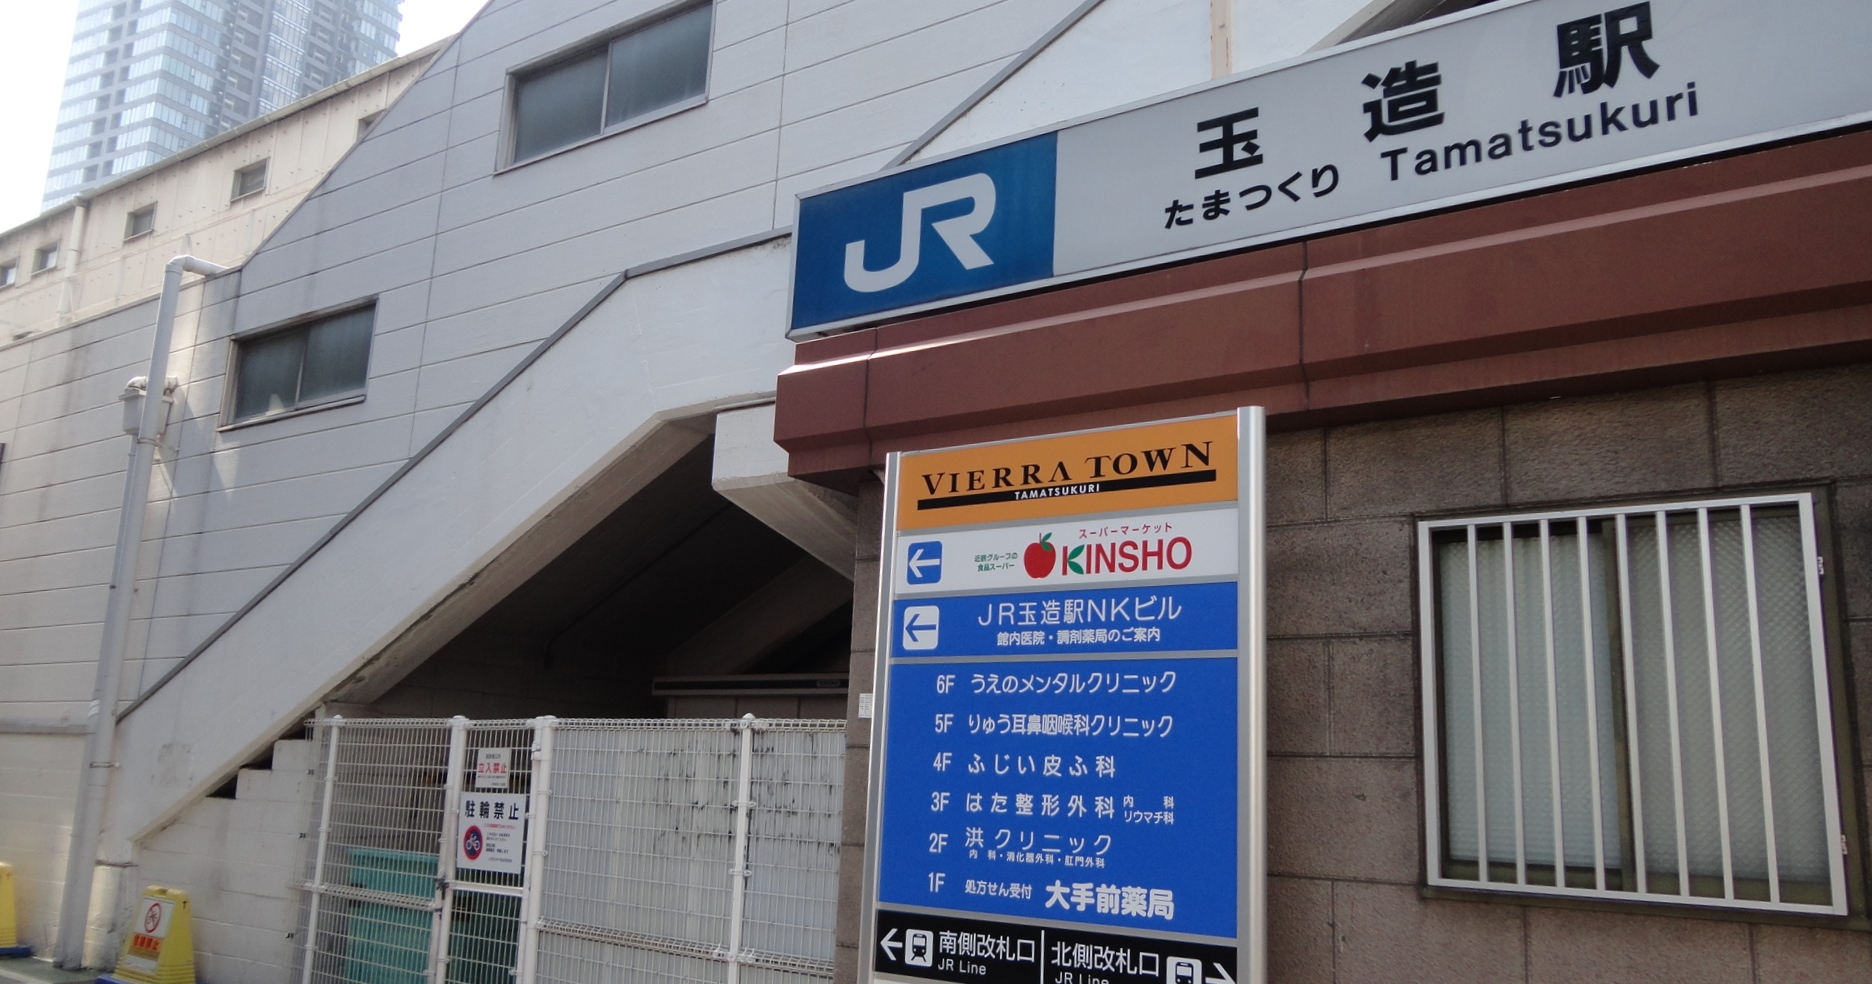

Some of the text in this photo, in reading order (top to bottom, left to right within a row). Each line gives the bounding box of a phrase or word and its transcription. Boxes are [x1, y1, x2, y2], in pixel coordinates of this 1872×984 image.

[1194, 1, 1660, 179] 玉造駅
[1380, 82, 1698, 182] Tamatsukuri
[1164, 164, 1340, 231] たまつくり
[844, 172, 997, 293] JR
[922, 441, 1214, 496] VIERRA TOWN
[1014, 483, 1100, 500] TAMATSUKURI
[1079, 522, 1172, 540] スーパーマーケット
[977, 562, 1015, 572] 食品スーパー
[1061, 536, 1193, 576] KINSHO
[978, 596, 1182, 627] JR玉造駅NKビル
[996, 627, 1161, 646] 館内医院・調剤薬局のご案内
[936, 671, 1177, 694] 6F うえのメンタルクリニック
[934, 713, 1174, 738] 5F りゅう耳鼻咽喉科クリニック
[478, 762, 508, 774] 立入禁止
[932, 752, 1116, 778] 4F ふじい皮ふ科
[464, 800, 520, 821] 駐輪禁止
[930, 791, 1115, 819] 3F はた整形外科
[1123, 810, 1174, 825] リウマチ科
[928, 833, 949, 853] 2F
[928, 872, 1175, 921] 1F 処方せん受付 大手前薬局
[939, 930, 1035, 963] 南側改札口
[1051, 941, 1160, 977] 北側改札口
[938, 958, 987, 975] JR Line
[1055, 971, 1073, 984] JR
